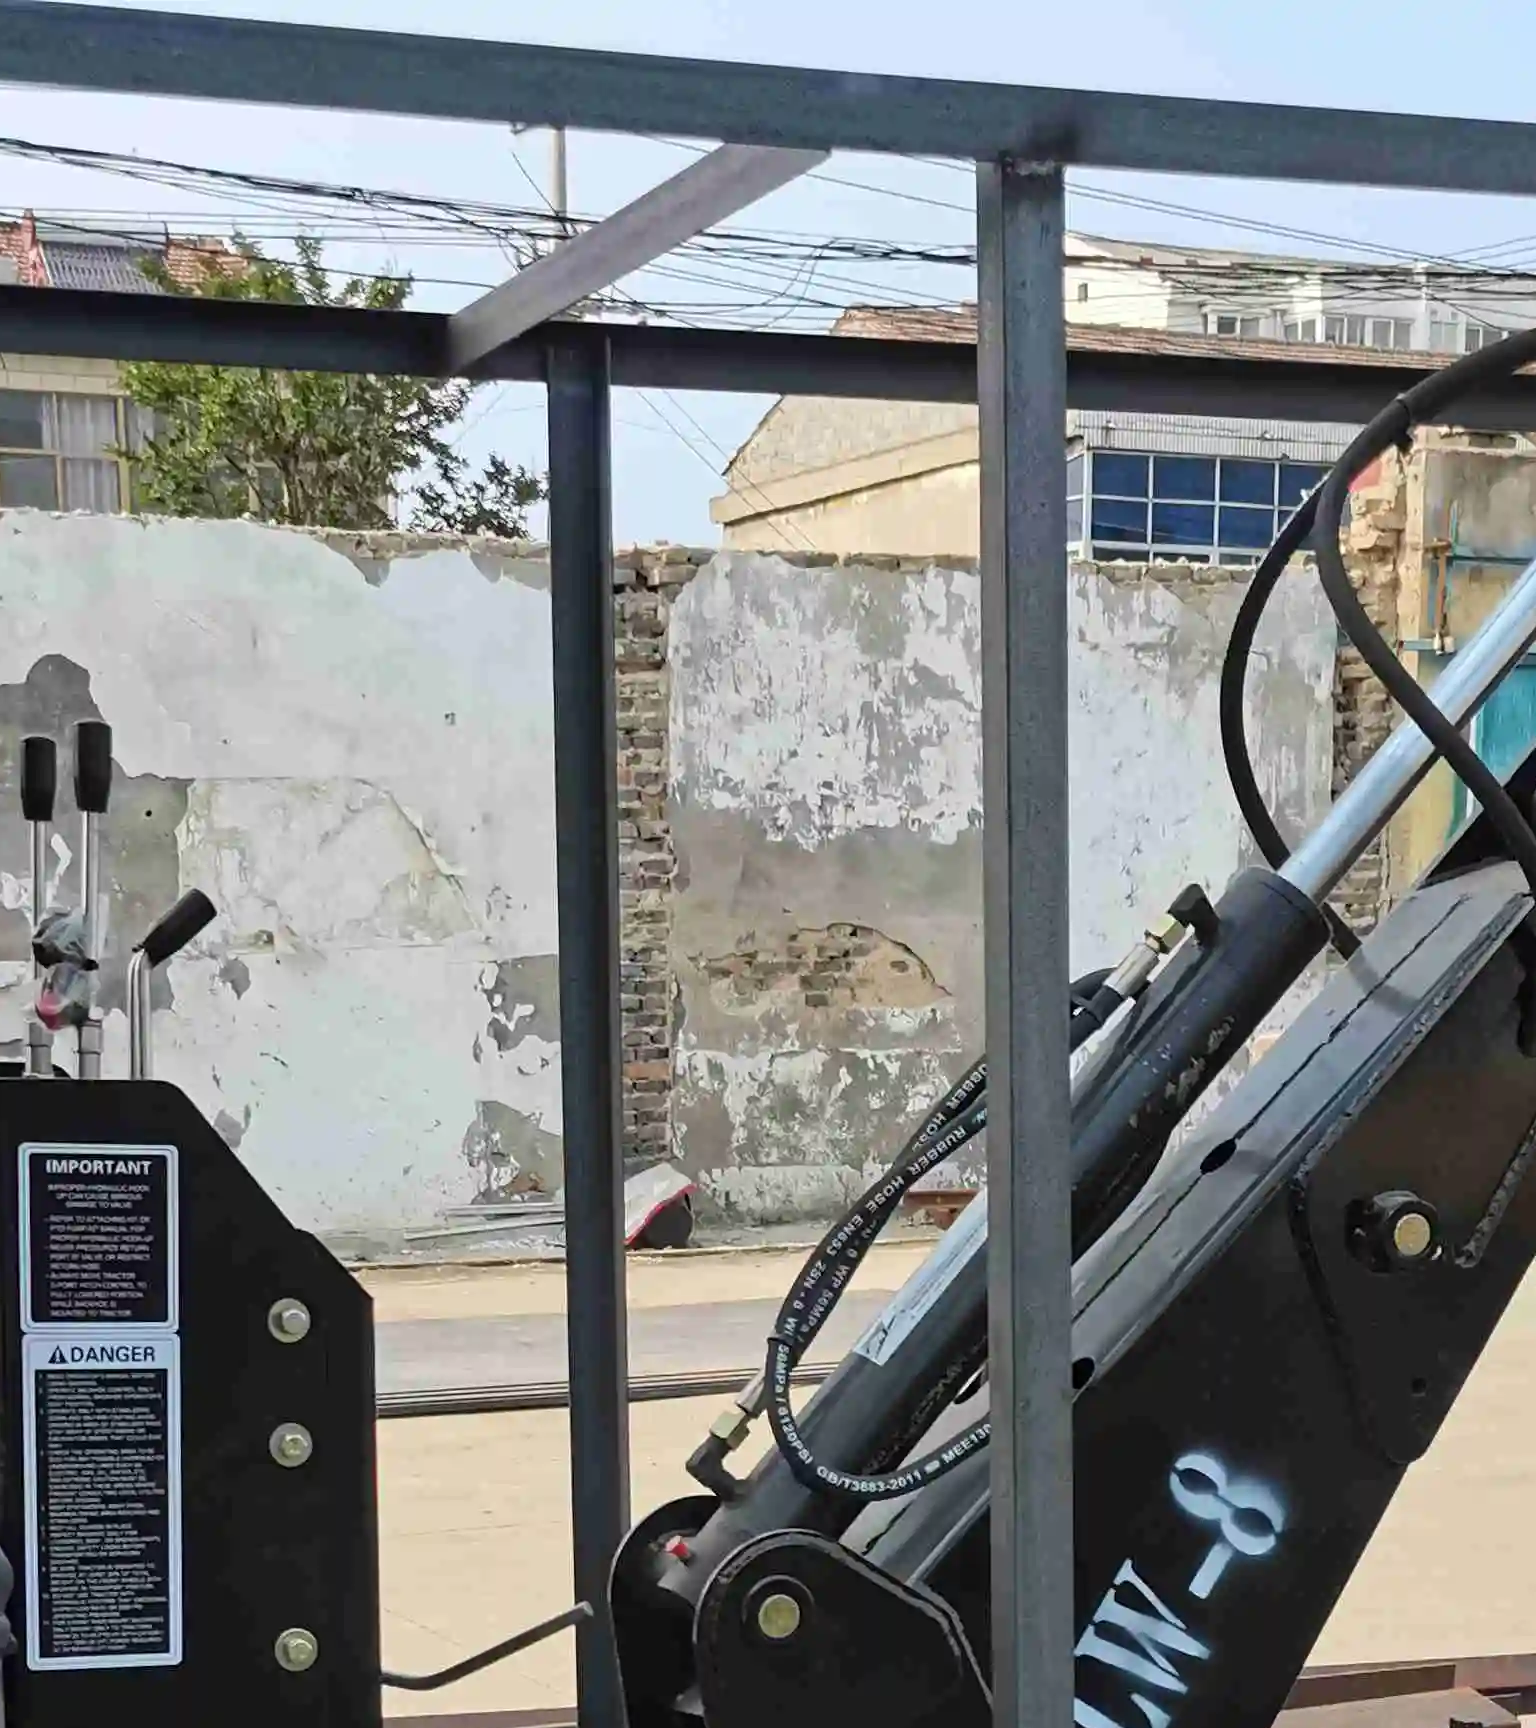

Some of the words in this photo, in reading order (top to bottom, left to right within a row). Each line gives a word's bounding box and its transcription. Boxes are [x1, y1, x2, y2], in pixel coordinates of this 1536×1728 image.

[946, 1063, 987, 1110] UBBER
[46, 1159, 152, 1175] IMPORTANT
[906, 1125, 966, 1176] RUBBER
[865, 1175, 905, 1214] HOSE
[71, 1346, 156, 1363] DANGER
